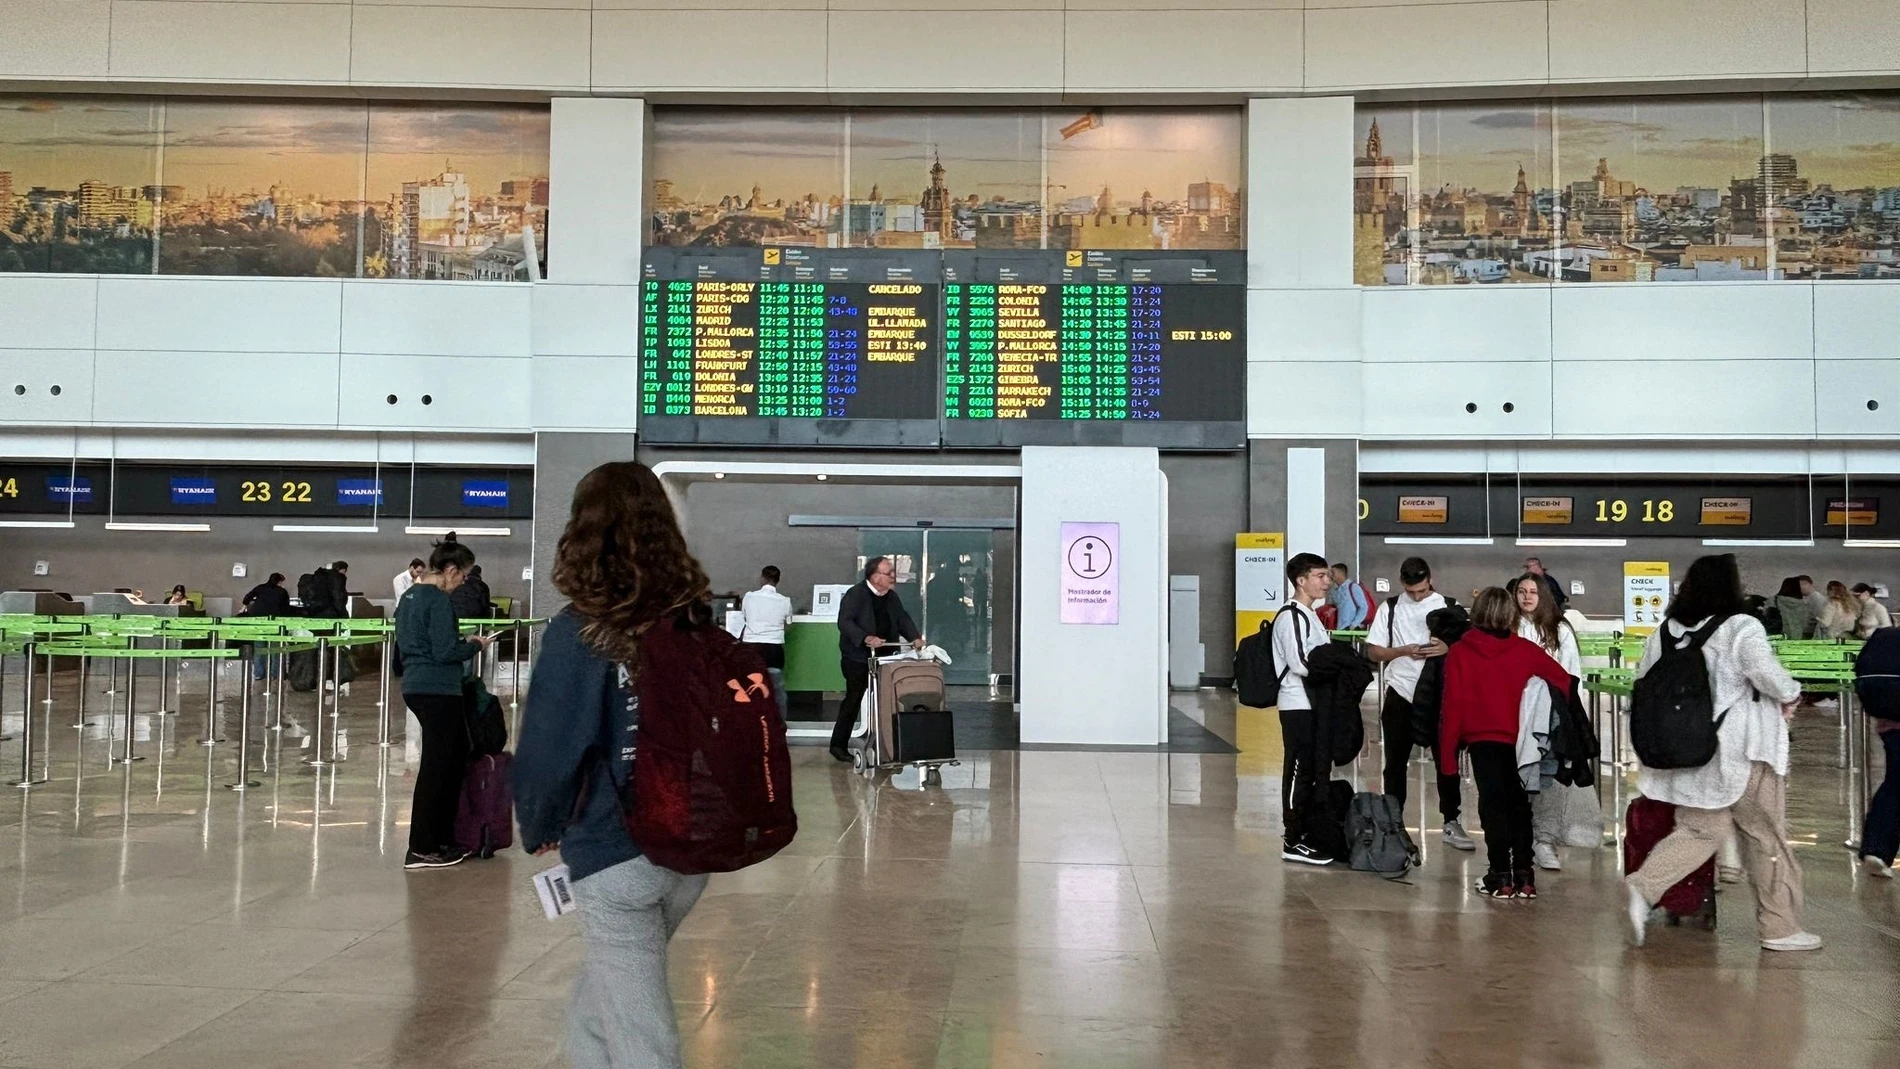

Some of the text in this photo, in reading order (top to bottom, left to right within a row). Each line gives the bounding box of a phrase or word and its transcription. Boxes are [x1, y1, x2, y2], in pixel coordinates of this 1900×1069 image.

[646, 282, 658, 290] TO
[697, 283, 755, 291] PARIS-ORLY
[761, 284, 789, 292] 11:45
[794, 284, 824, 292] 11:10
[869, 285, 921, 293] CANCELADO
[947, 285, 960, 293] IB
[999, 286, 1046, 294] ROMA-FCO
[1097, 286, 1126, 294] 13:25
[646, 293, 657, 301] AF
[668, 294, 692, 302] 1417
[697, 294, 749, 303] PARIS-CDG
[760, 295, 789, 303] 12:20
[794, 296, 824, 304] 11:45
[999, 297, 1039, 305] COLONIA
[1063, 297, 1092, 305] 14:05
[668, 305, 690, 313] 2141
[696, 305, 731, 314] ZURICH
[760, 306, 789, 314] 12:20
[868, 307, 915, 316] EMBARQUE
[998, 308, 1039, 317] SEVILLA
[1097, 309, 1127, 317] 13:35
[696, 316, 731, 325] MADRID
[794, 318, 823, 326] 11:53
[947, 319, 1160, 328] FR SANTIAGO 14:20 13:45 21-24
[645, 327, 657, 335] FR
[668, 327, 691, 335] 7372
[696, 327, 754, 336] P.MALLORCA
[760, 329, 789, 337] 12:35
[829, 330, 857, 338] 21-24
[868, 330, 915, 338] EMBARQUE
[998, 330, 1057, 339] DUSSELDORF
[1096, 331, 1126, 339] 14:25
[1172, 331, 1195, 340] ESTI
[1201, 331, 1231, 340] 15:00
[646, 338, 657, 346] TP
[696, 338, 730, 347] LISBOA
[760, 340, 789, 348] 12:35
[868, 341, 891, 349] ESTI
[897, 341, 926, 350] 13:40
[998, 342, 1057, 350] P.MALLORCA
[1062, 342, 1092, 350] 14:50
[1132, 343, 1160, 351] 17-20
[645, 349, 657, 357] FR
[696, 350, 753, 359] LONDRES-ST
[760, 351, 788, 359] 12:40
[793, 352, 823, 360] 11:57
[828, 353, 857, 361] 21-24
[868, 352, 915, 361] EMBARQUE
[947, 353, 959, 361] FR
[1096, 354, 1126, 362] 14:20
[645, 360, 823, 371] LH FRANKFURT 12:50 12:15
[947, 364, 959, 372] LX
[969, 364, 993, 372] 2143
[998, 363, 1034, 373] ZURICH
[1062, 365, 1091, 373] 15:00
[1096, 365, 1126, 373] 14:25
[644, 372, 657, 380] FR
[695, 372, 736, 381] BOLONIA
[793, 374, 822, 382] 12:35
[828, 375, 856, 383] 21-24
[947, 375, 965, 383] EZS
[998, 375, 1038, 384] GINEBRA
[1062, 376, 1091, 384] 15:05
[1096, 376, 1126, 384] 14:35
[644, 383, 661, 391] EZY
[759, 385, 788, 393] 13:10
[793, 385, 822, 393] 12:35
[998, 385, 1051, 395] MARRAKECH
[1132, 388, 1160, 396] 21-24
[645, 394, 656, 402] IB
[695, 395, 735, 403] MENORCA
[759, 396, 787, 404] 13:25
[828, 397, 845, 405] 1-2
[998, 398, 1045, 406] ROMA-FCO
[1062, 399, 1091, 407] 15:15
[1096, 399, 1126, 407] 14:40
[644, 405, 845, 416] IB BARCELONA 13:45 13:20 1-2
[946, 409, 959, 417] FR
[998, 409, 1027, 418] SOFIA
[1062, 410, 1091, 418] 15:25
[1096, 410, 1126, 418] 14:50
[0, 477, 19, 498] 4
[241, 481, 312, 502] 23 22
[1595, 499, 1674, 523] 19 18
